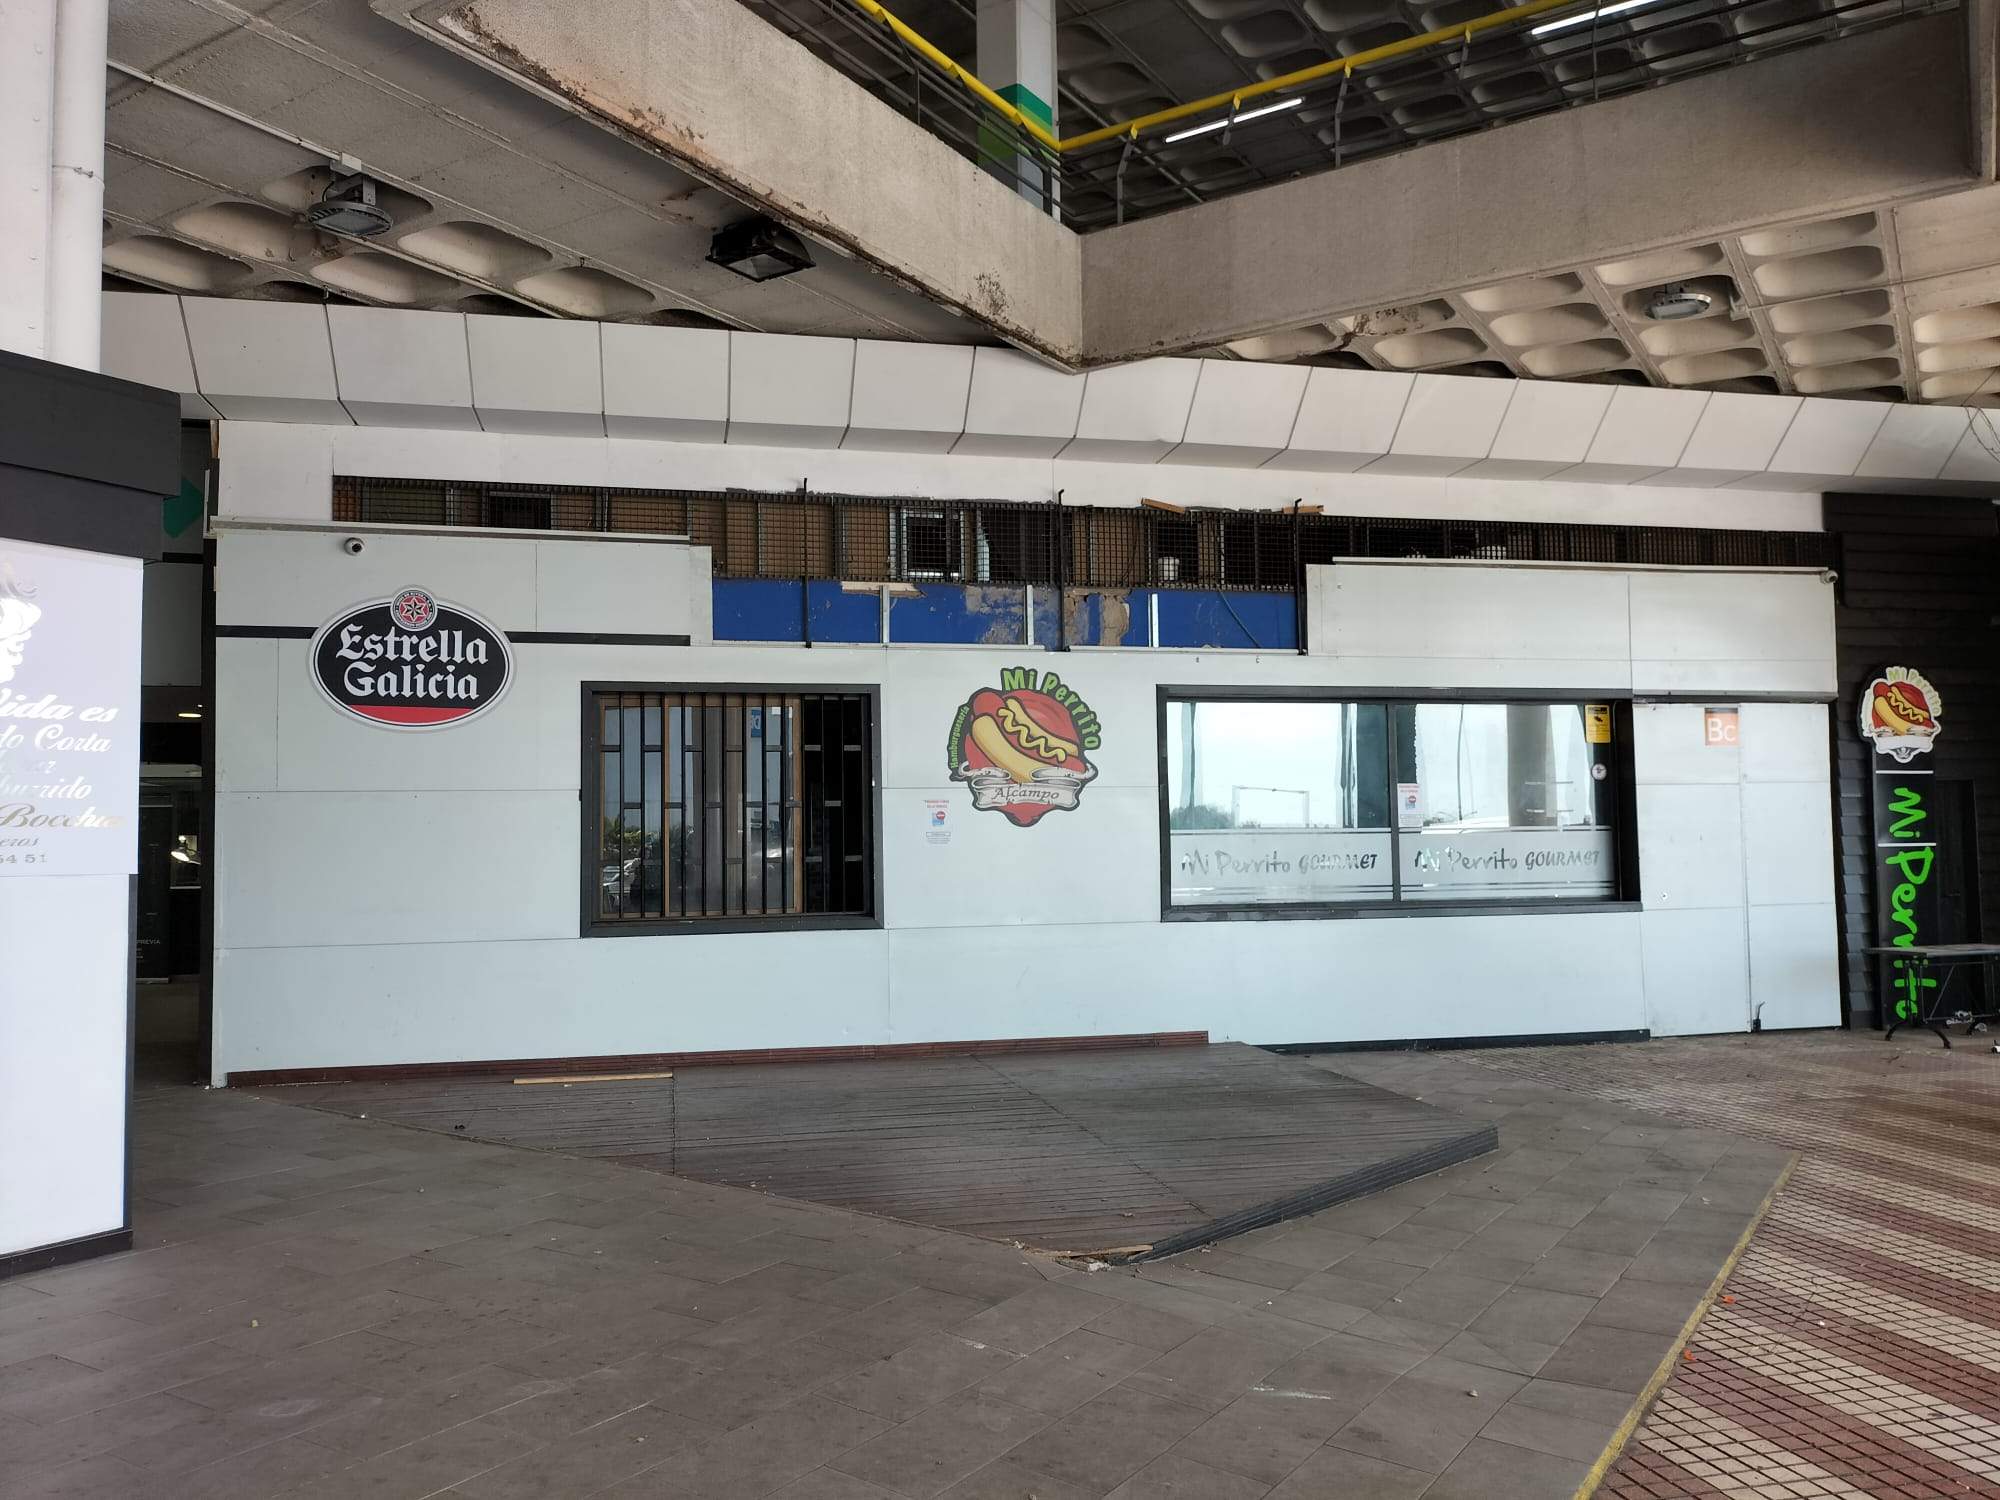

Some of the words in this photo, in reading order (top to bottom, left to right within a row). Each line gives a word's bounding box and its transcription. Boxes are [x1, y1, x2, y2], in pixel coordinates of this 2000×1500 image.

[336, 623, 489, 665] Estrella
[343, 661, 480, 700] Galicia
[79, 705, 119, 722] es
[1001, 667, 1037, 691] Mi
[1040, 672, 1101, 750] Perrito
[34, 723, 113, 753] Corta
[1707, 717, 1737, 743] Bc
[991, 786, 1060, 801] Alcampo
[1886, 786, 1927, 839] Mi
[24, 853, 48, 864] 51
[1215, 849, 1292, 877] Perrito
[1445, 847, 1518, 875] Perrito
[1525, 848, 1600, 871] GOURMET
